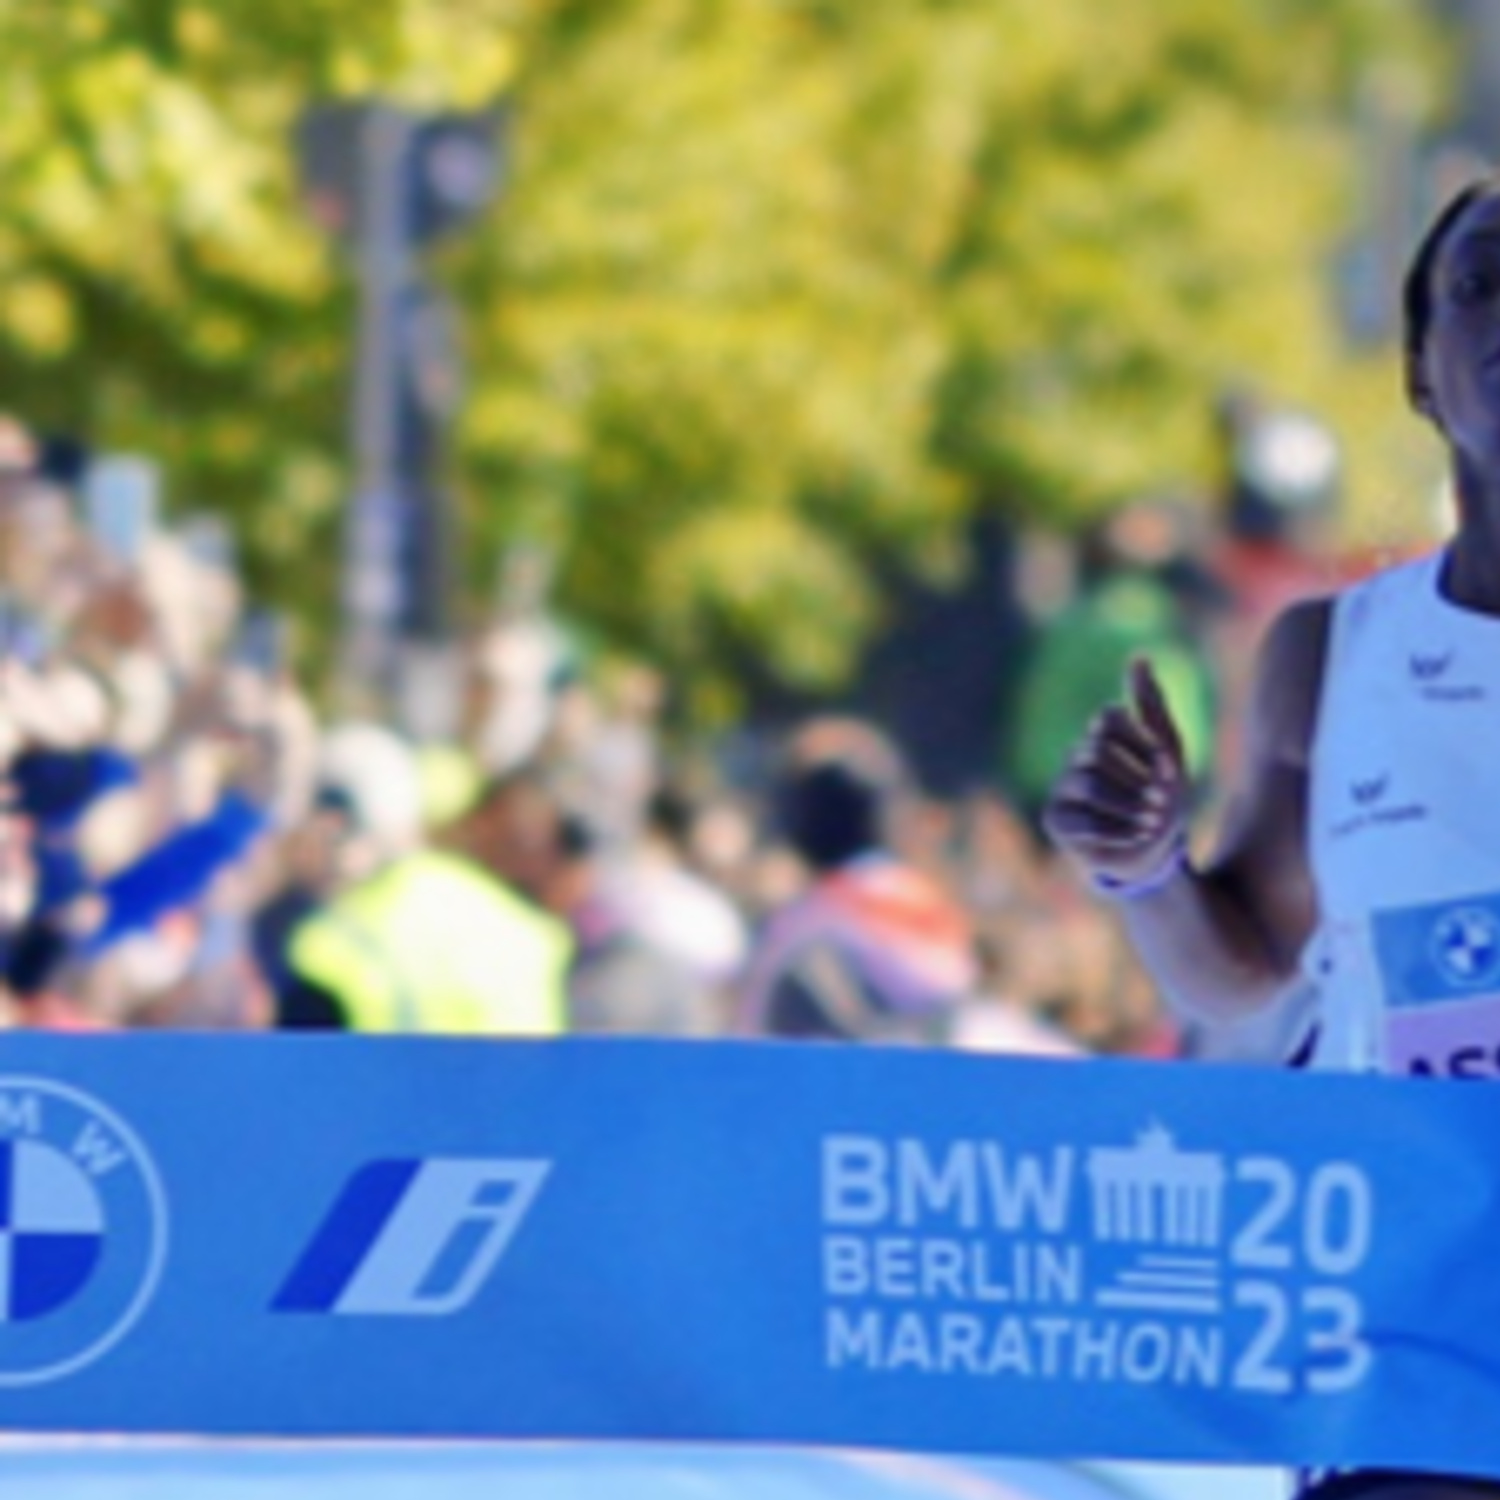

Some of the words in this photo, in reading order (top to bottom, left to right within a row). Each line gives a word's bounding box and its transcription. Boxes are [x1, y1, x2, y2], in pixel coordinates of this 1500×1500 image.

[820, 1136, 1072, 1232] BMW
[1231, 1157, 1372, 1275] 20
[822, 1236, 1083, 1305] BERLIN
[825, 1307, 1223, 1388] MARATHON
[1231, 1279, 1372, 1393] 23
